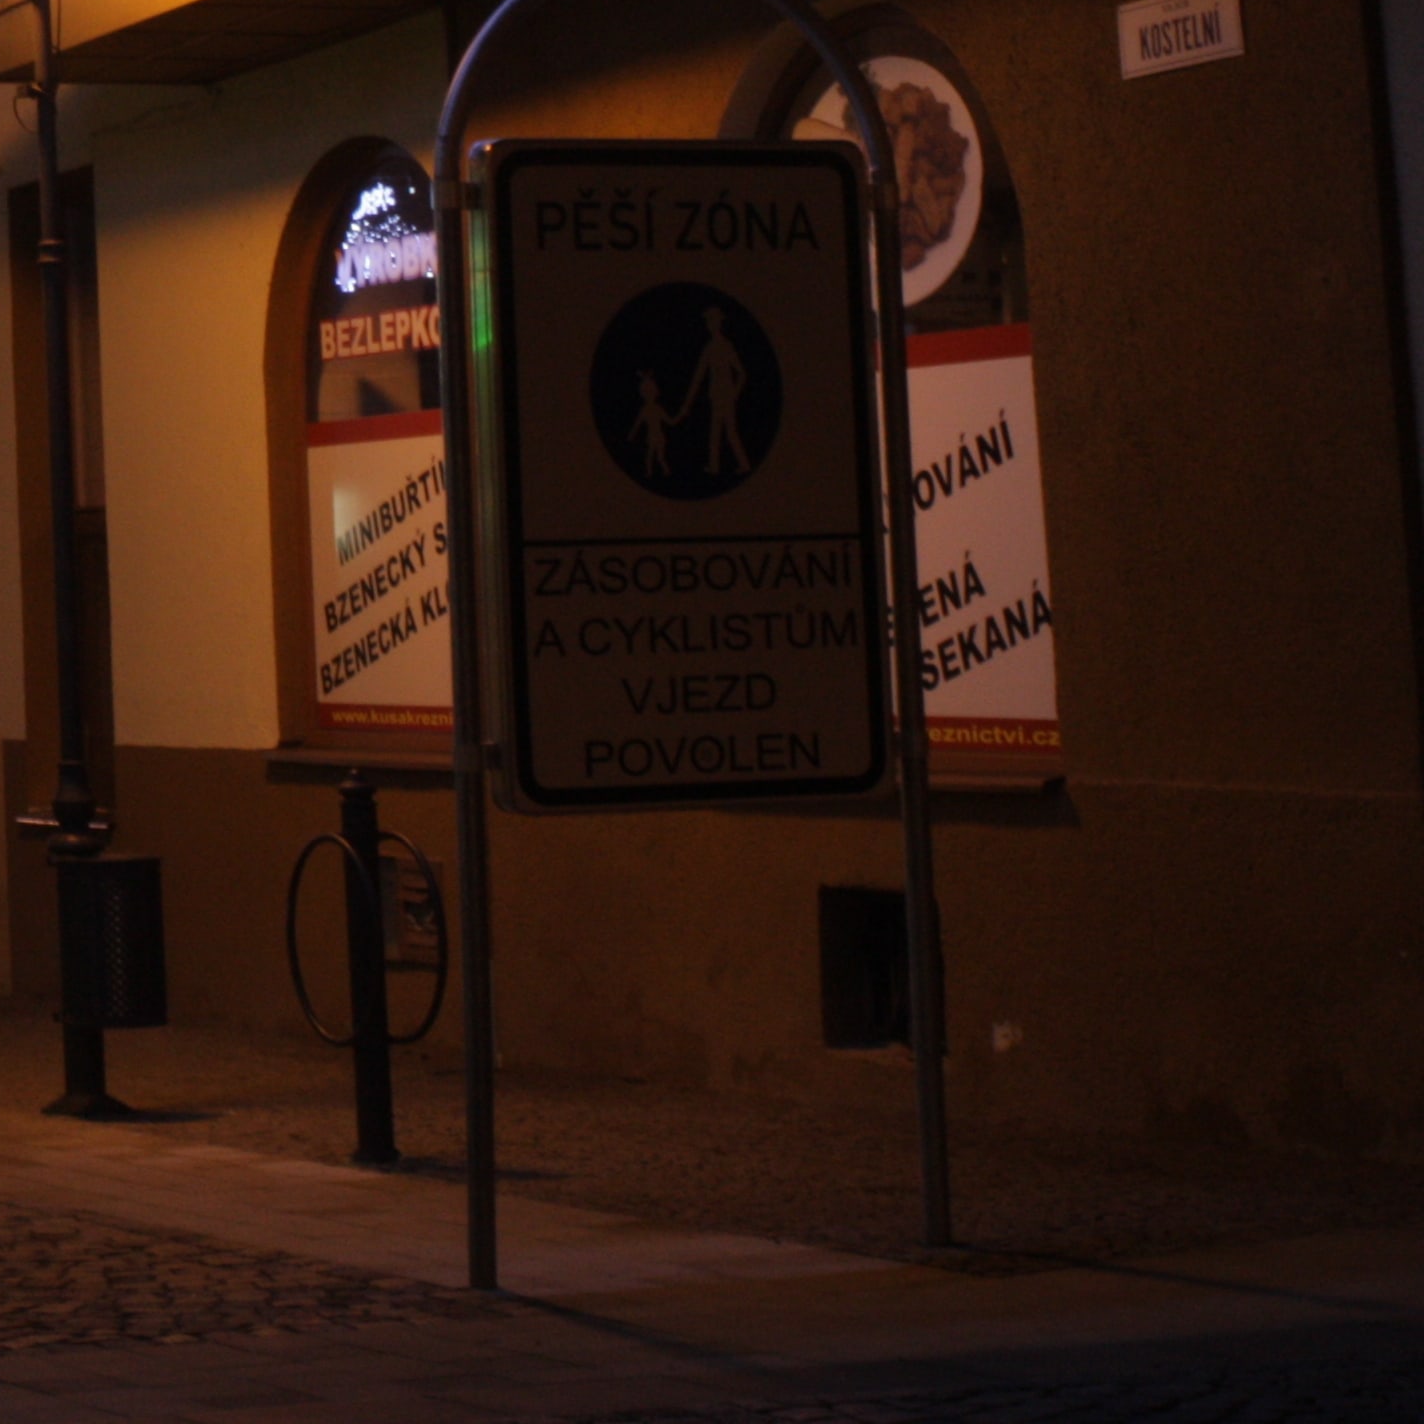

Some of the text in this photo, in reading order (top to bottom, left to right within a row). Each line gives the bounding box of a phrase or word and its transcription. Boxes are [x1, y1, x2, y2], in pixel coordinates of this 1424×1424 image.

[1138, 2, 1222, 60] KOSTELNÍ
[536, 188, 819, 251] PĚŠÍ ZÓNA
[910, 407, 1014, 512] OVÁNÍ
[336, 456, 447, 566] MINIBUŘTÍ
[324, 529, 427, 633] BZENECKÝ
[534, 542, 852, 596] ZÁSOBOVÁNÍ
[916, 549, 985, 627] ENÁ
[320, 579, 450, 695] BZENECKÁ KL
[534, 620, 566, 658] A
[579, 604, 859, 655] CYKLISTŮM
[622, 673, 776, 715] VJEZD
[585, 732, 821, 776] POVOLEN
[925, 725, 1061, 746] eznictvi.cz
